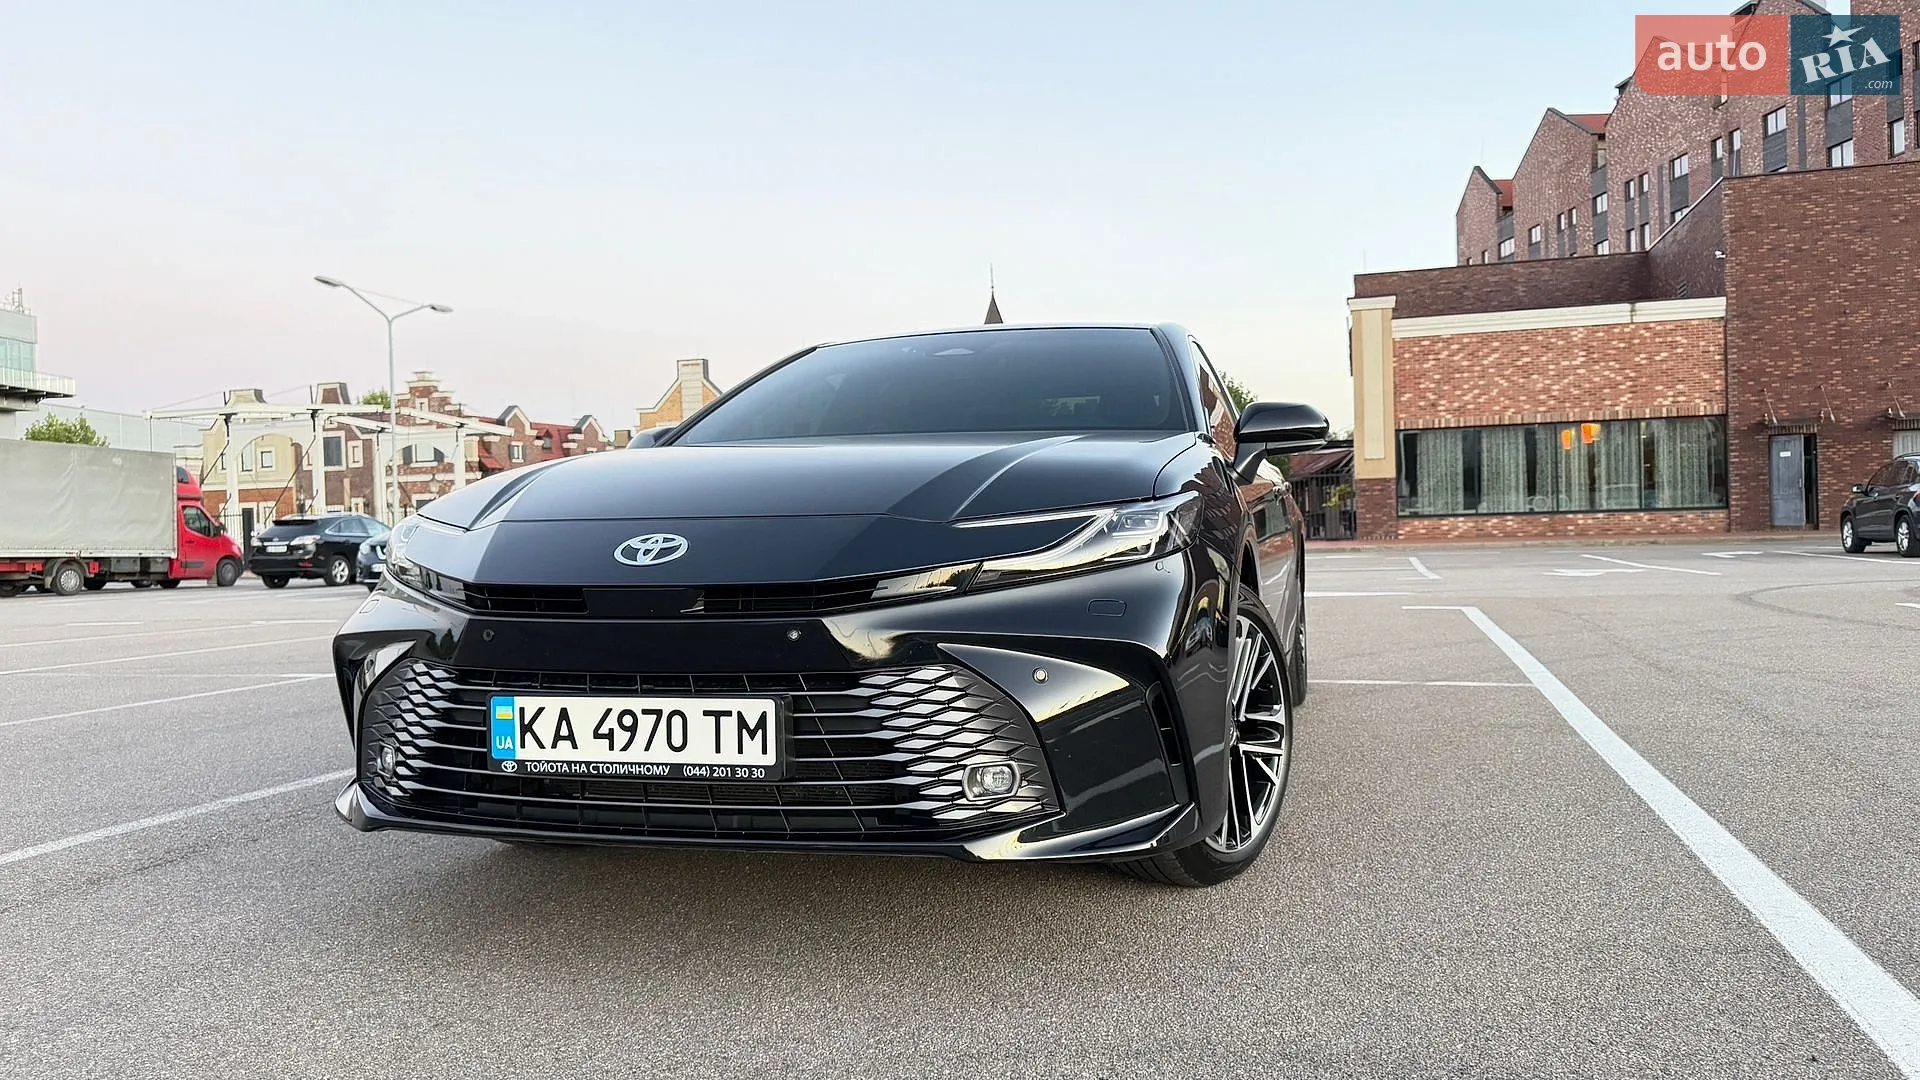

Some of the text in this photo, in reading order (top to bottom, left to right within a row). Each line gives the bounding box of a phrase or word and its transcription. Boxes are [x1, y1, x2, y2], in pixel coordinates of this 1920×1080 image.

[519, 706, 768, 755] KA 4970 TM
[496, 736, 513, 750] UA
[525, 760, 765, 778] ТОЙОТА НА СТОЛИЧНОМУ (044) 201 30 30
